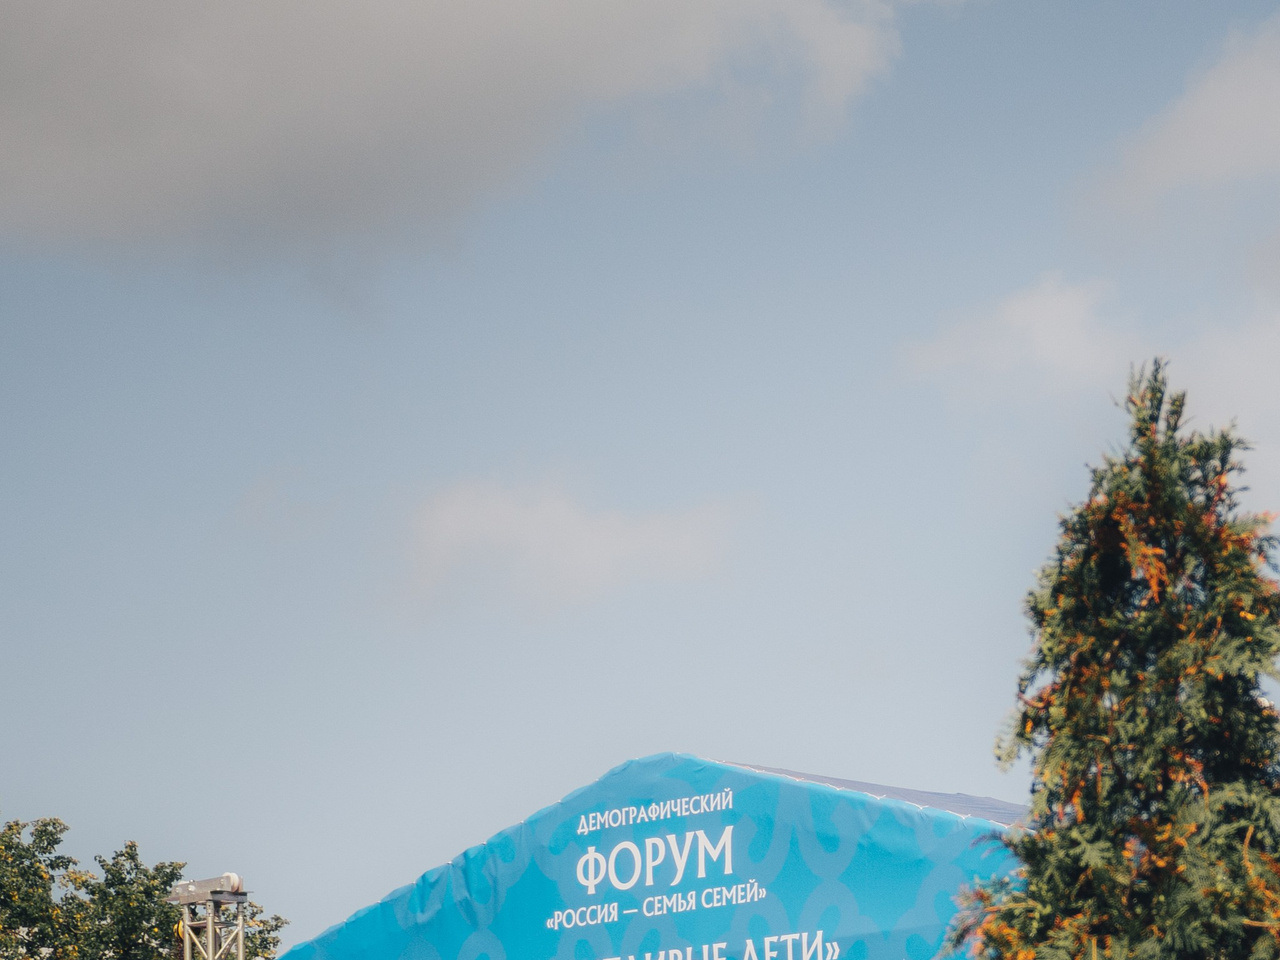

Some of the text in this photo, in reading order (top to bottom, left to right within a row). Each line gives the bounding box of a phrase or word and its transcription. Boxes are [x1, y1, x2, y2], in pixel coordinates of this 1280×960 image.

[576, 787, 734, 835] ДЕМОГРАФИЧЕСКИЙ
[576, 825, 734, 895] ФОРУМ
[546, 902, 618, 930] «РОССИЯ
[642, 890, 697, 918] СЕМЬЯ
[701, 879, 767, 909] СЕМЕЙ»
